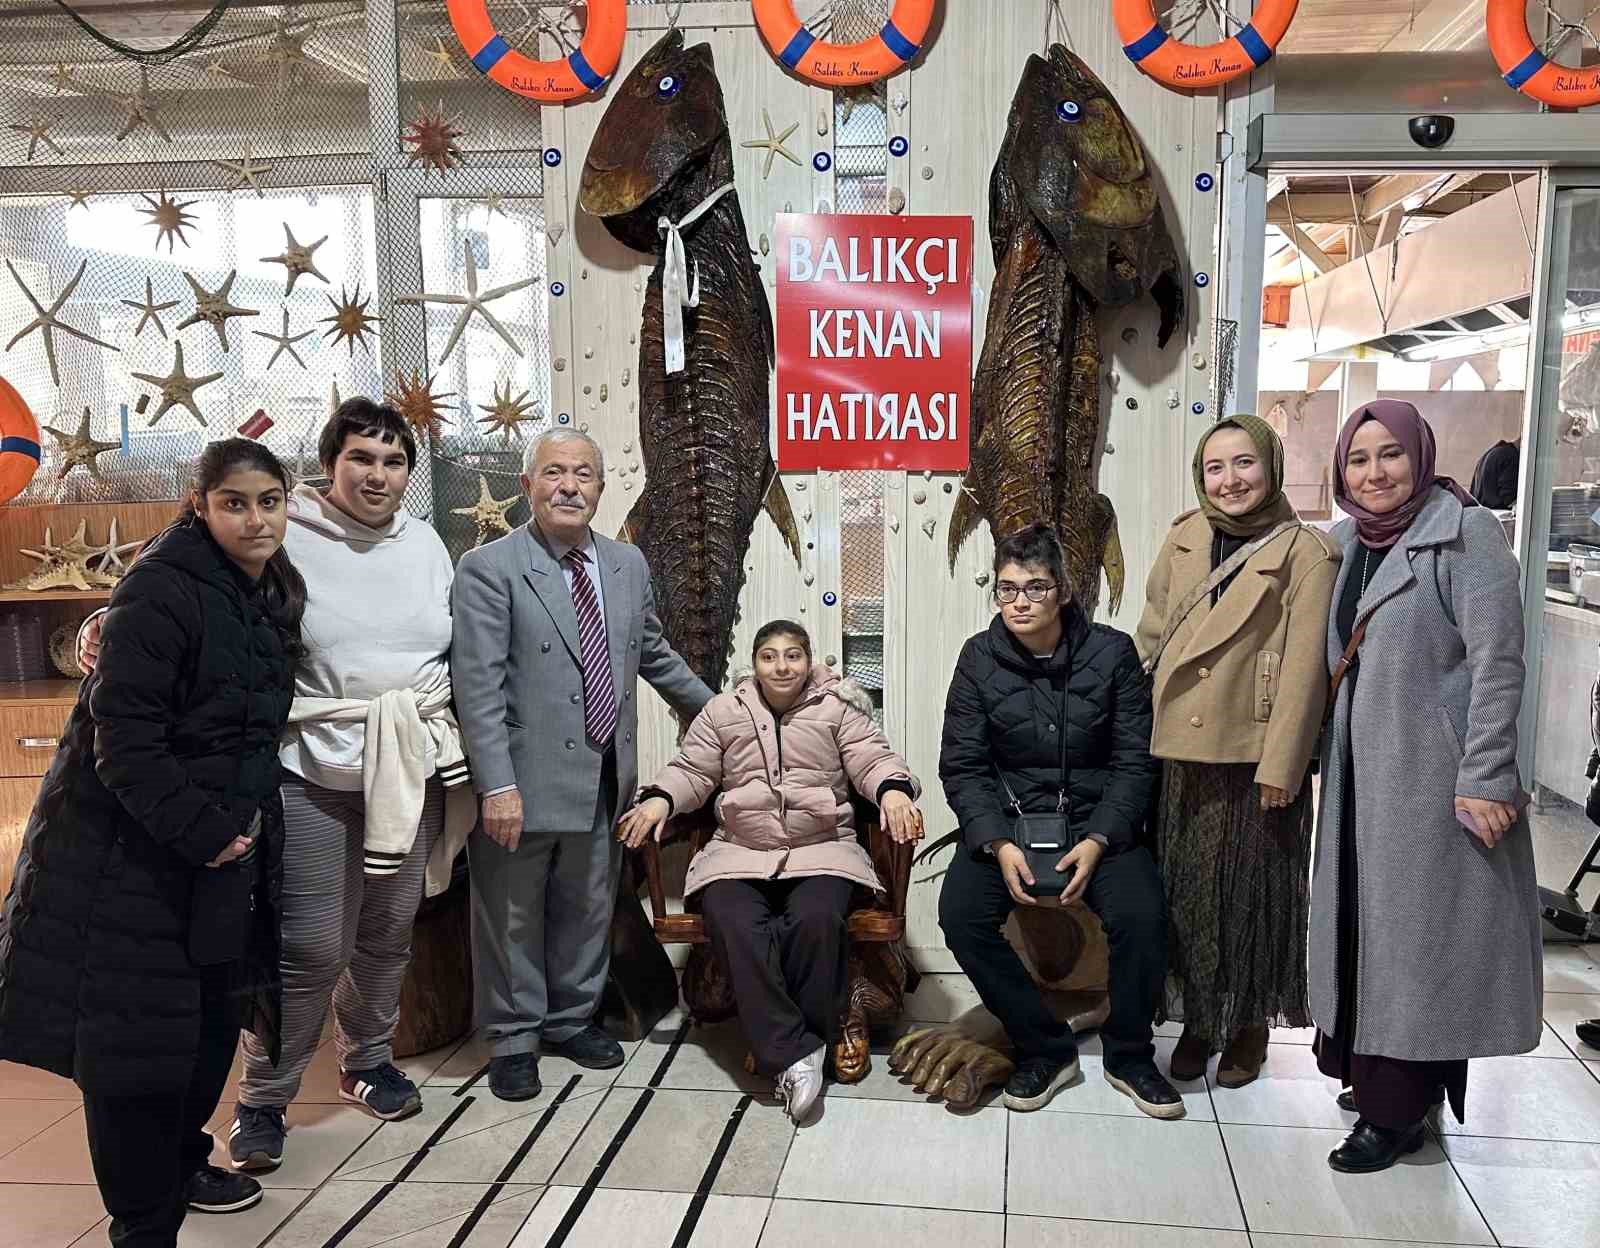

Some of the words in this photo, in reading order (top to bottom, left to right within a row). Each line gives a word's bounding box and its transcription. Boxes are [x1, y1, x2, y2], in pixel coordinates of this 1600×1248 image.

[846, 61, 879, 77] Kenan
[1209, 57, 1242, 75] Kenan
[543, 77, 575, 93] Kenan
[787, 236, 959, 295] BALIKÇI
[808, 308, 942, 358] KENAN
